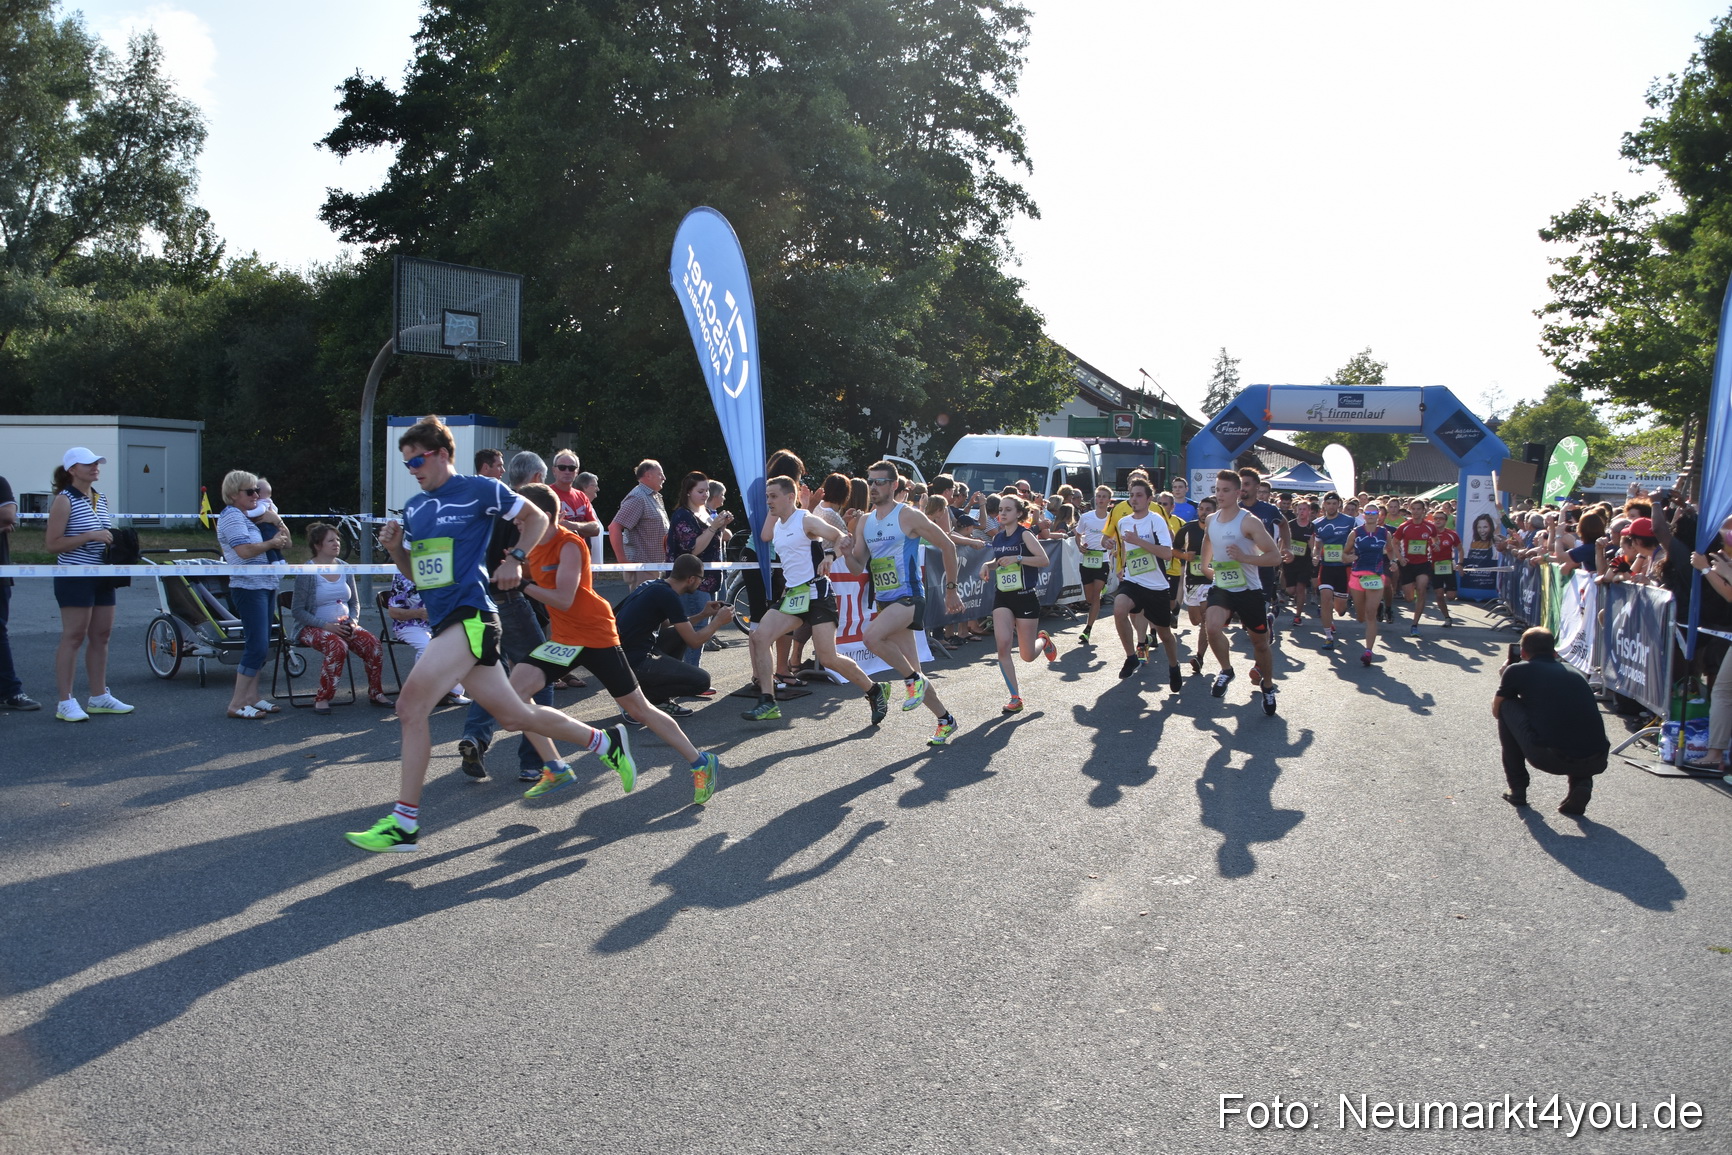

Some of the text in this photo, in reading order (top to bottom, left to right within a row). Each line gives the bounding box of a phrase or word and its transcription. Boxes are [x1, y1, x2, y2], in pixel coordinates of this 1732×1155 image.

[1328, 408, 1386, 419] firmenlauf
[1221, 424, 1252, 433] Fischer
[1602, 472, 1626, 480] Jura
[1545, 474, 1565, 497] AOK
[418, 557, 443, 576] 956
[1131, 557, 1149, 569] 278
[874, 571, 898, 587] 5193
[1001, 573, 1017, 585] 368
[1221, 570, 1239, 581] 353
[956, 575, 986, 599] scher
[788, 595, 805, 608] 977
[543, 644, 577, 658] 1030
